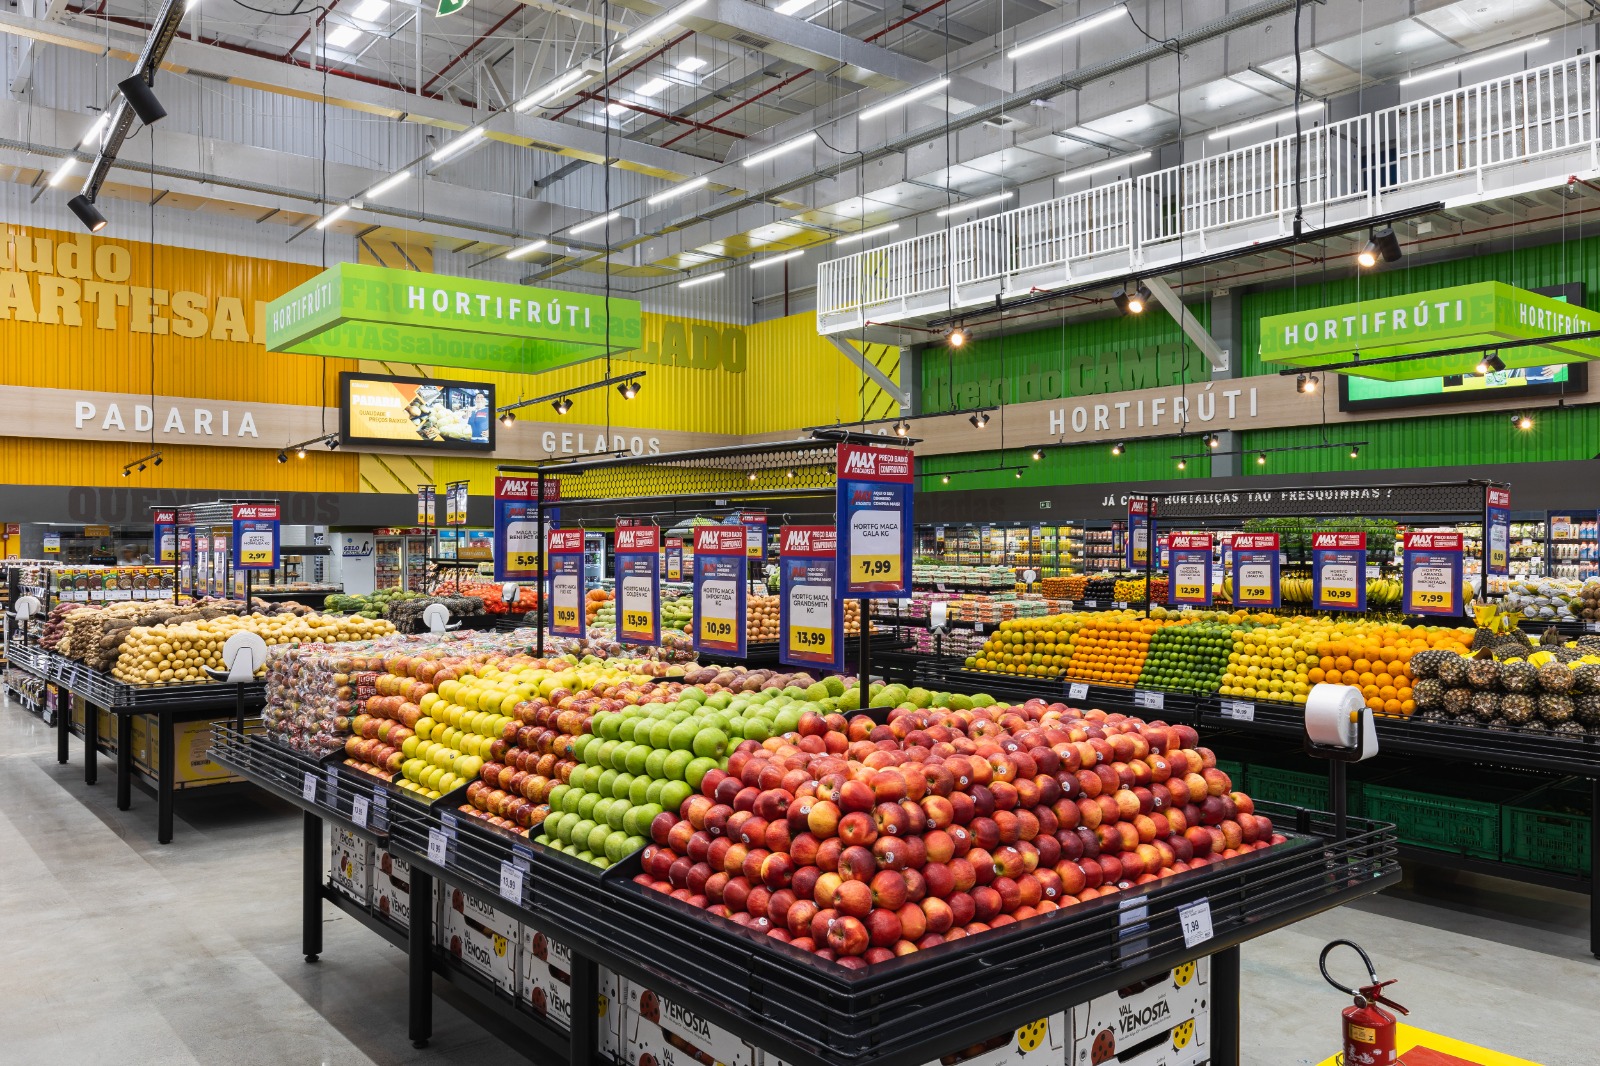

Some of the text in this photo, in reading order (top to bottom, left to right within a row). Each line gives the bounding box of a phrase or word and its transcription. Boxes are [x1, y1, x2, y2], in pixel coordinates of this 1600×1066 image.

[273, 282, 332, 334] HORTIFRÚTI
[408, 286, 590, 328] HORTIFRÚTI
[1285, 300, 1462, 345] HORTIFRÚTI
[352, 394, 401, 408] PADARIA
[1049, 382, 1257, 436] HORTIFRÚTI
[75, 401, 259, 438] PADARIA
[541, 431, 660, 457] GELADOS
[844, 451, 877, 473] MAX
[880, 465, 907, 474] COMPROVADO
[501, 480, 529, 495] MAX
[1102, 494, 1115, 506] JÁ
[157, 513, 174, 522] MAX
[237, 508, 257, 518] MAX
[550, 533, 565, 549] MAX
[617, 531, 635, 548] MAX
[698, 531, 719, 549] MAX
[785, 531, 810, 551] MAX
[1172, 536, 1190, 548] MAX
[1234, 536, 1253, 548] MAX
[1315, 535, 1338, 546] MAX
[1408, 535, 1433, 547] MAX
[862, 561, 891, 576] 7,99
[1181, 587, 1200, 595] 12,99
[1327, 590, 1351, 598] 10,99
[1420, 594, 1443, 603] 7,99
[557, 611, 575, 622] 10,99
[627, 615, 648, 627] 13,99
[706, 622, 731, 636] 10,99
[797, 632, 826, 647] 13,99
[503, 876, 516, 889] 13,99
[390, 898, 410, 919] VENOS
[1184, 920, 1200, 934] 7,99
[463, 940, 492, 968] VENOSTA
[549, 981, 558, 995] VAL
[1119, 1003, 1132, 1017] VAL
[1119, 999, 1170, 1035] VENOSTA
[664, 997, 711, 1040] VENOSTA
[662, 1047, 674, 1063] VAL
